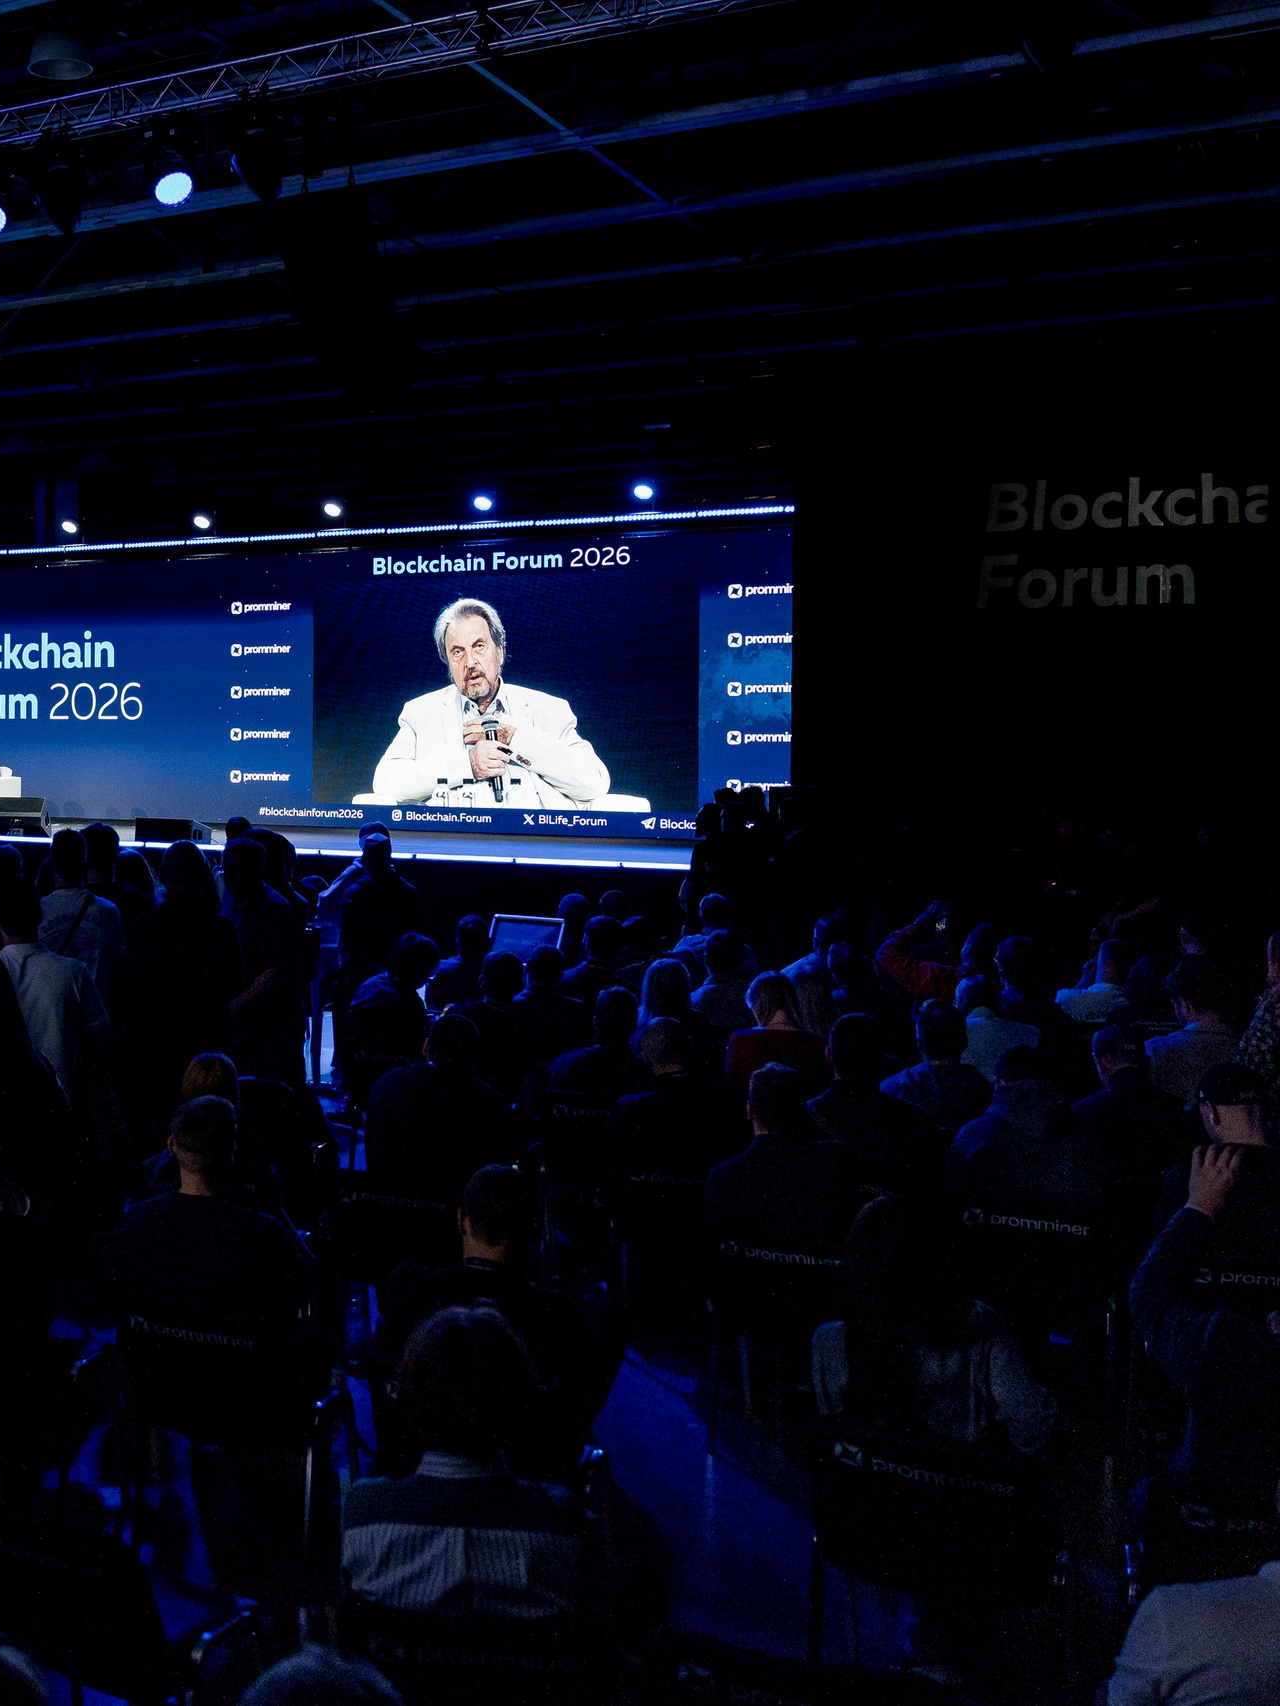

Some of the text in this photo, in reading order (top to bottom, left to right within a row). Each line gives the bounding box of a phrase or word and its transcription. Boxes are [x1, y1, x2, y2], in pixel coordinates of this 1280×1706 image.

[373, 546, 631, 574] Blockchain Forum 2026
[976, 553, 1196, 610] Forum
[243, 601, 291, 612] promminer
[243, 644, 291, 655] promminer
[243, 686, 291, 697] promminer
[49, 682, 143, 720] 2026
[243, 729, 291, 740] promminer
[243, 772, 291, 782] promminer
[258, 807, 364, 819] #blockchainforum2026
[405, 811, 492, 823] Blockchain.Forum
[991, 1213, 1090, 1236] promminer
